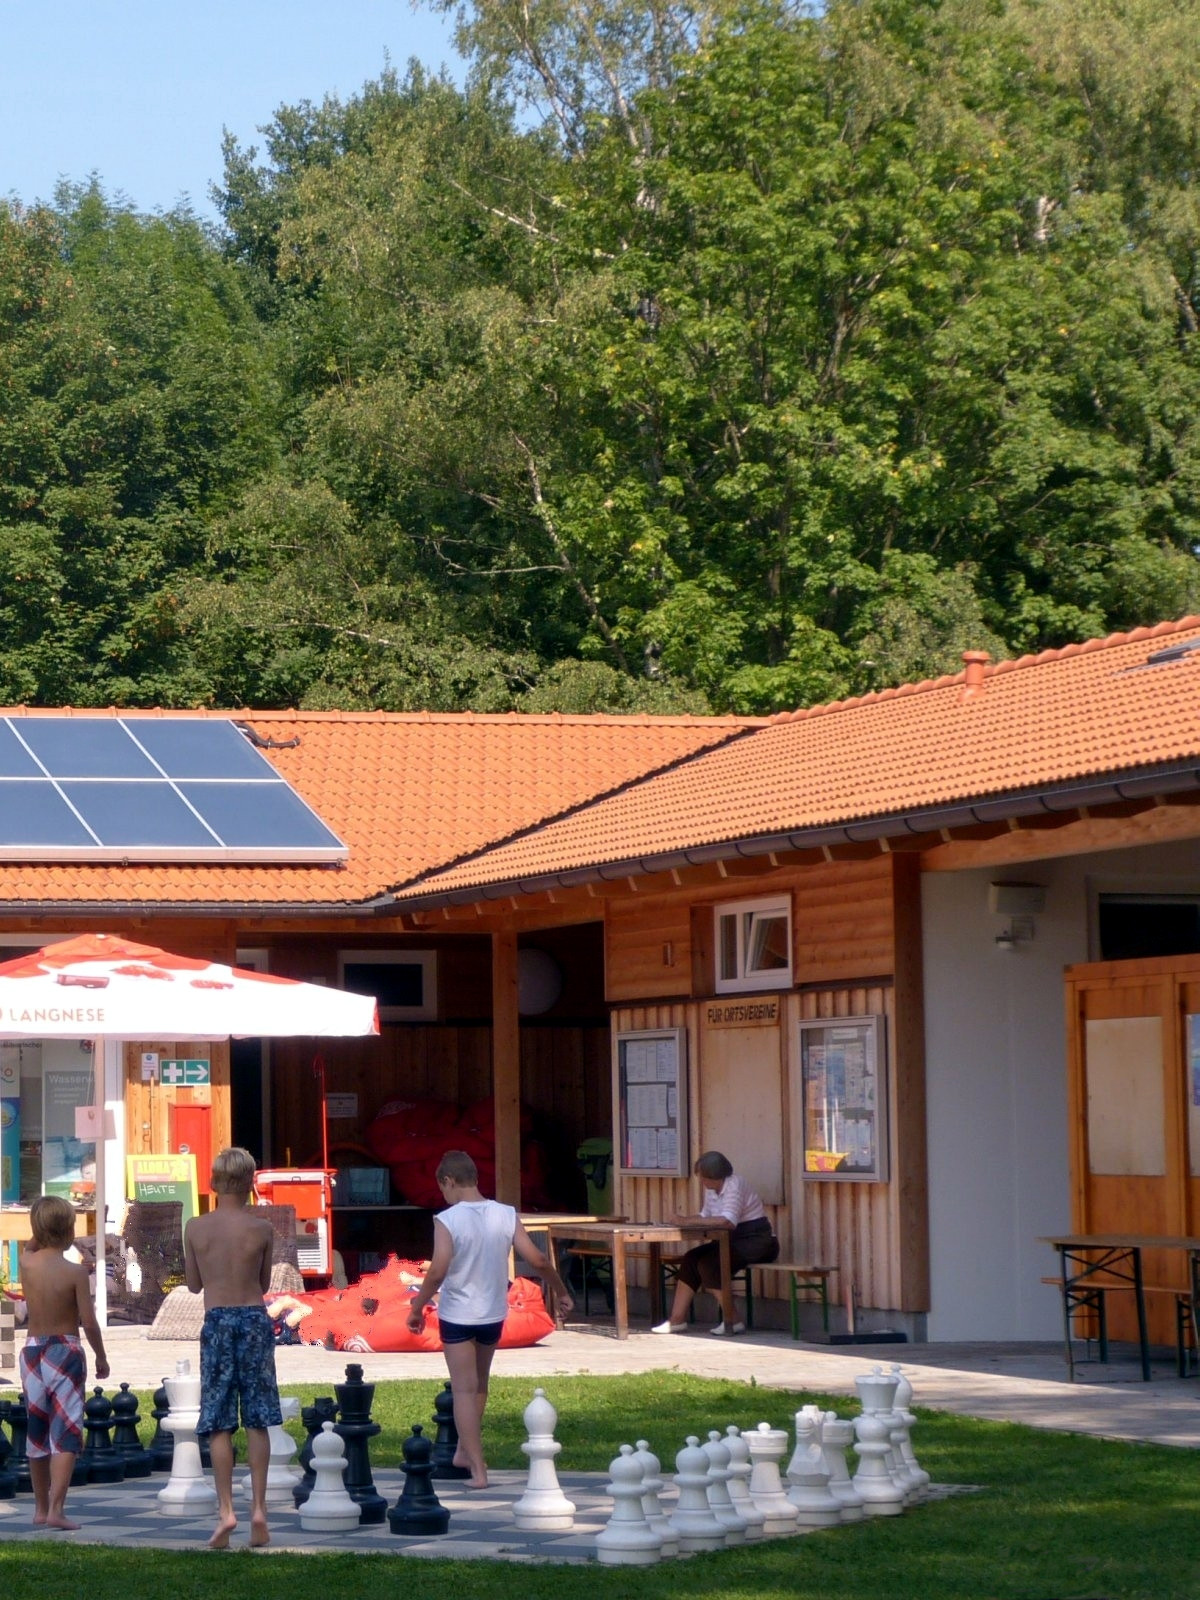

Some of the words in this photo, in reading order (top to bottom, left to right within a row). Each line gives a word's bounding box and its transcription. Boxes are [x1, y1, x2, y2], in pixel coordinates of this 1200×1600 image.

[9, 1008, 105, 1022] LANGNESE
[724, 1003, 777, 1022] ORTSVEREINE
[137, 1161, 170, 1175] ALOHA
